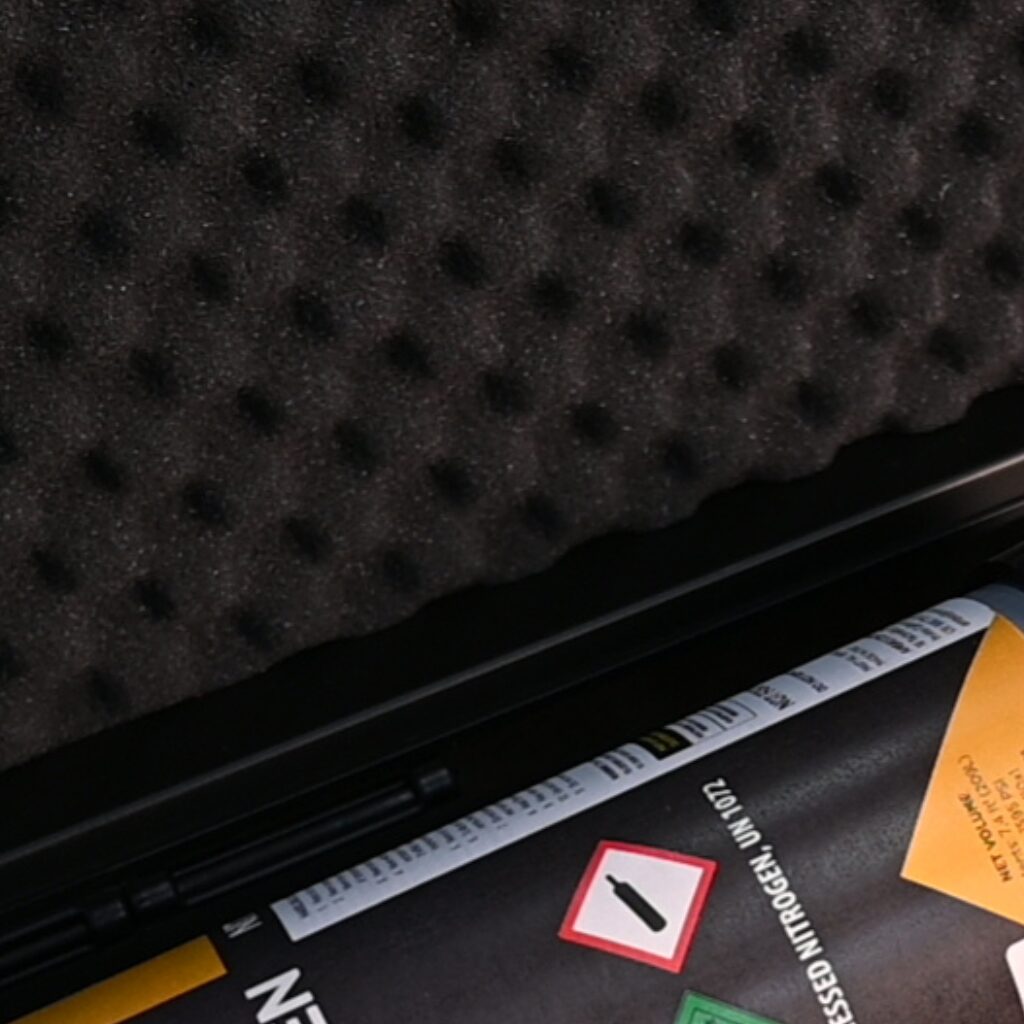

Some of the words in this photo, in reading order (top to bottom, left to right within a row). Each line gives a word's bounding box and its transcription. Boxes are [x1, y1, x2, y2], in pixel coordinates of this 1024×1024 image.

[703, 778, 739, 820] 1072
[728, 817, 761, 848] UN
[959, 794, 996, 851] VOLUME
[991, 855, 1012, 882] NET
[750, 846, 822, 961] NITROGEN,
